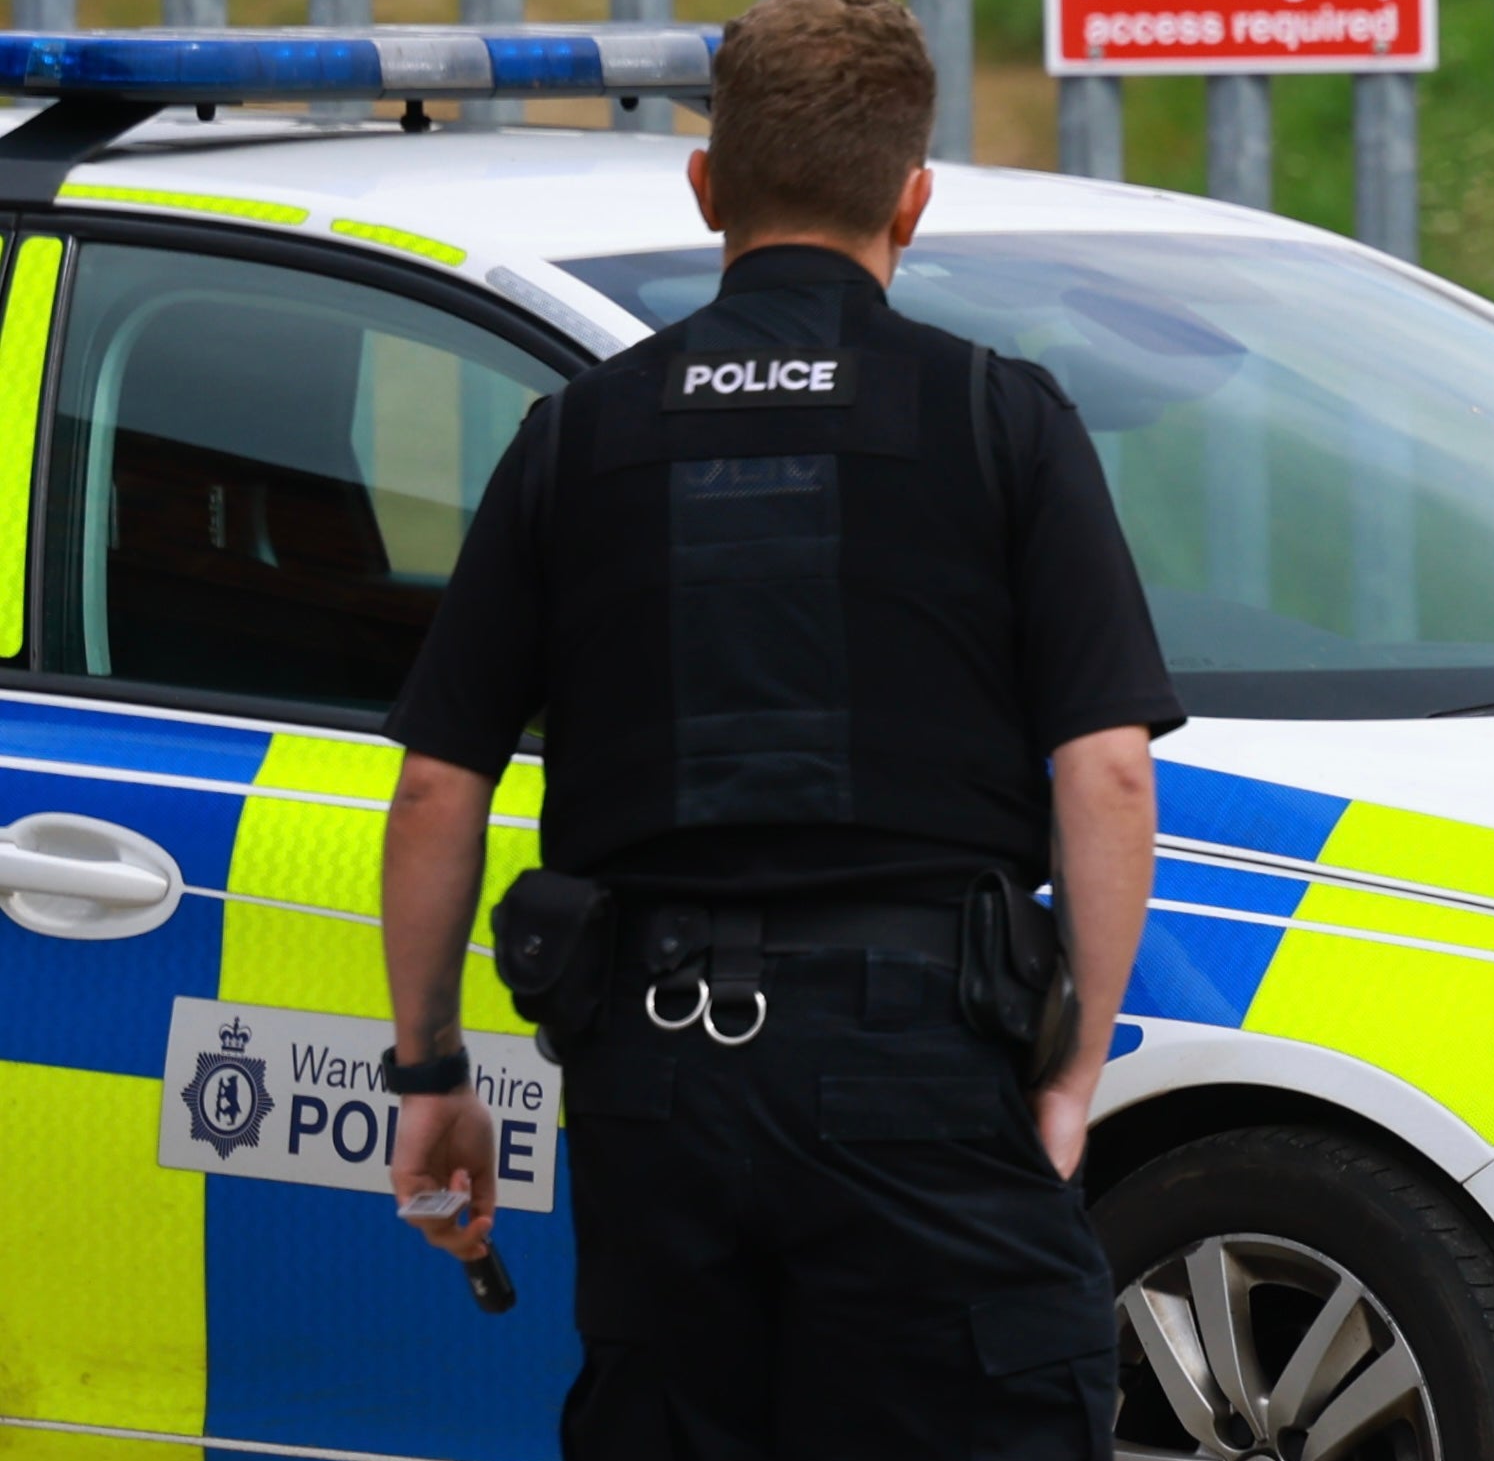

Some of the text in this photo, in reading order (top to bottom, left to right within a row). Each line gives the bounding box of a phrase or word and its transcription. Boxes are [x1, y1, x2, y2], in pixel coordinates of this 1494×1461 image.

[1084, 4, 1397, 51] access required
[683, 360, 838, 394] POLICE
[291, 1042, 543, 1111] Warwhire
